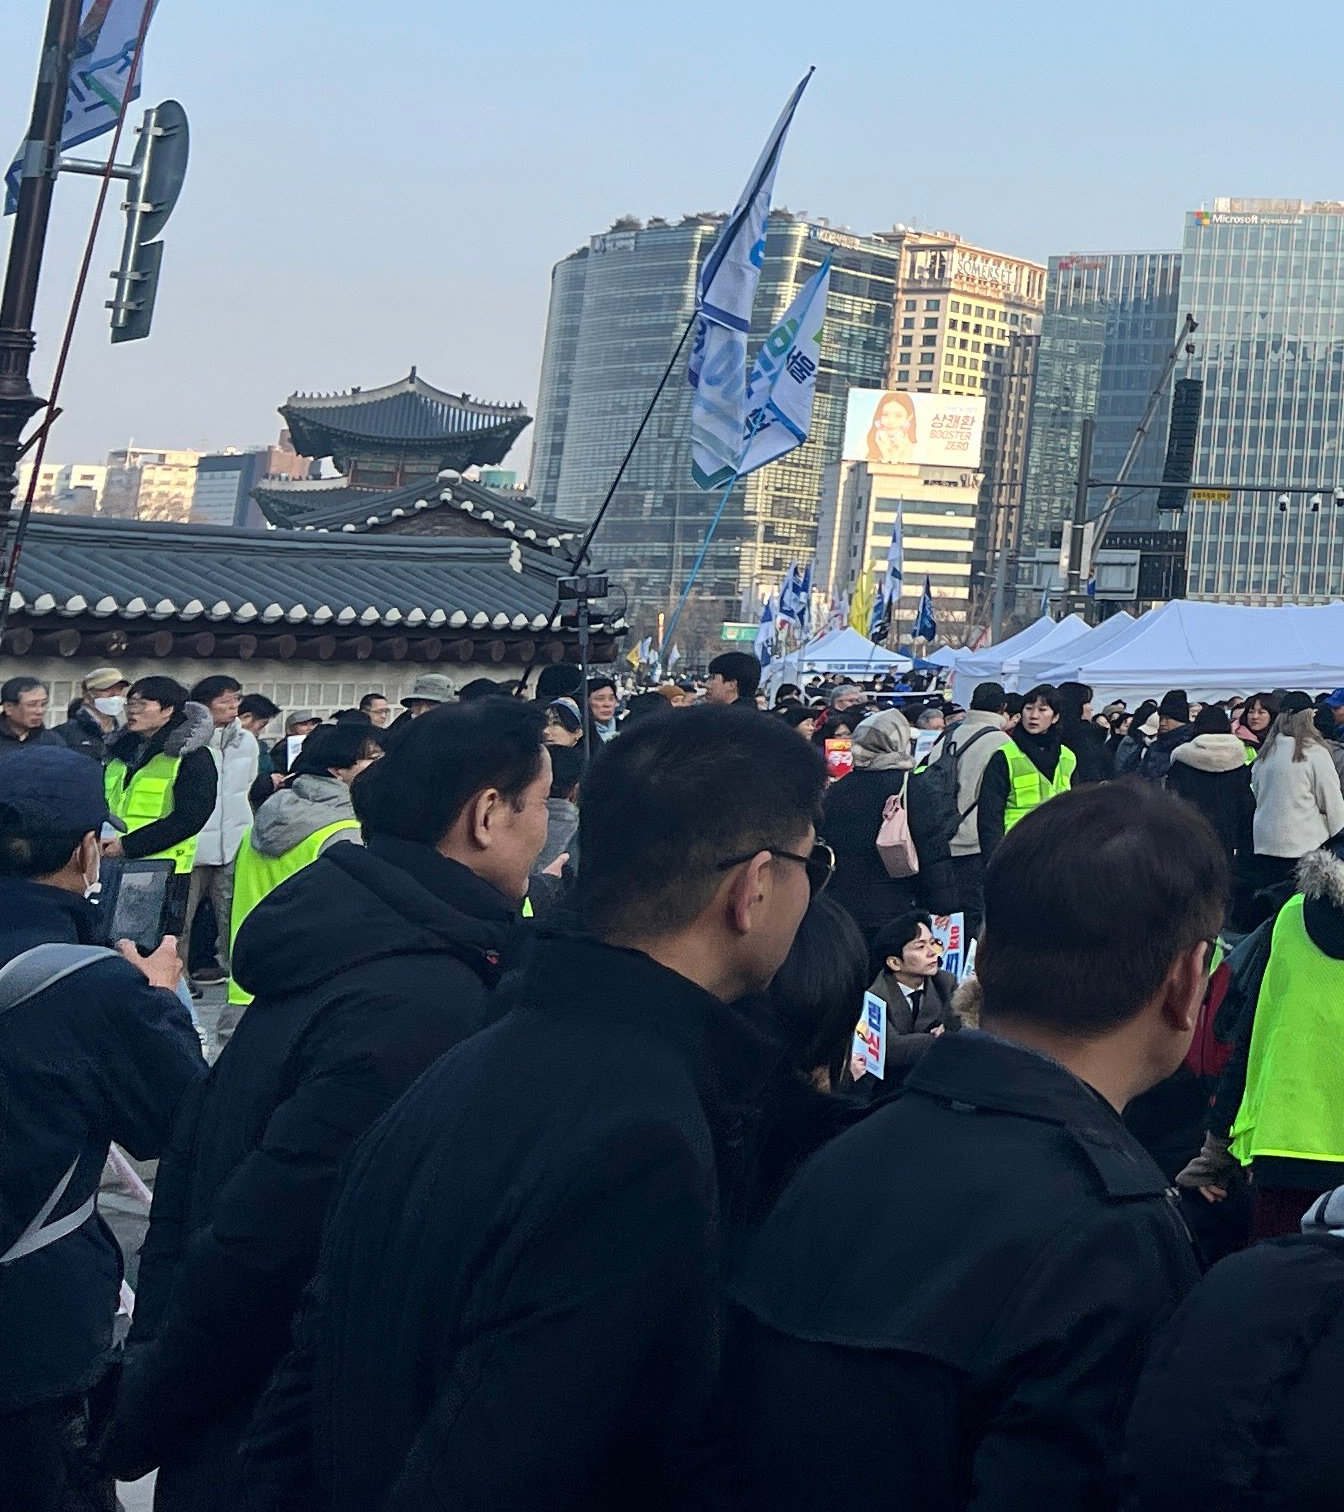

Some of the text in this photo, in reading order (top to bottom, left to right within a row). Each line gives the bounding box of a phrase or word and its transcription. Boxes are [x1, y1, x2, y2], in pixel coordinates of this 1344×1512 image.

[1212, 213, 1259, 225] Microsoft
[956, 259, 1014, 281] SOMERSET
[929, 429, 972, 441] BOOSTER
[944, 440, 969, 451] ZERO
